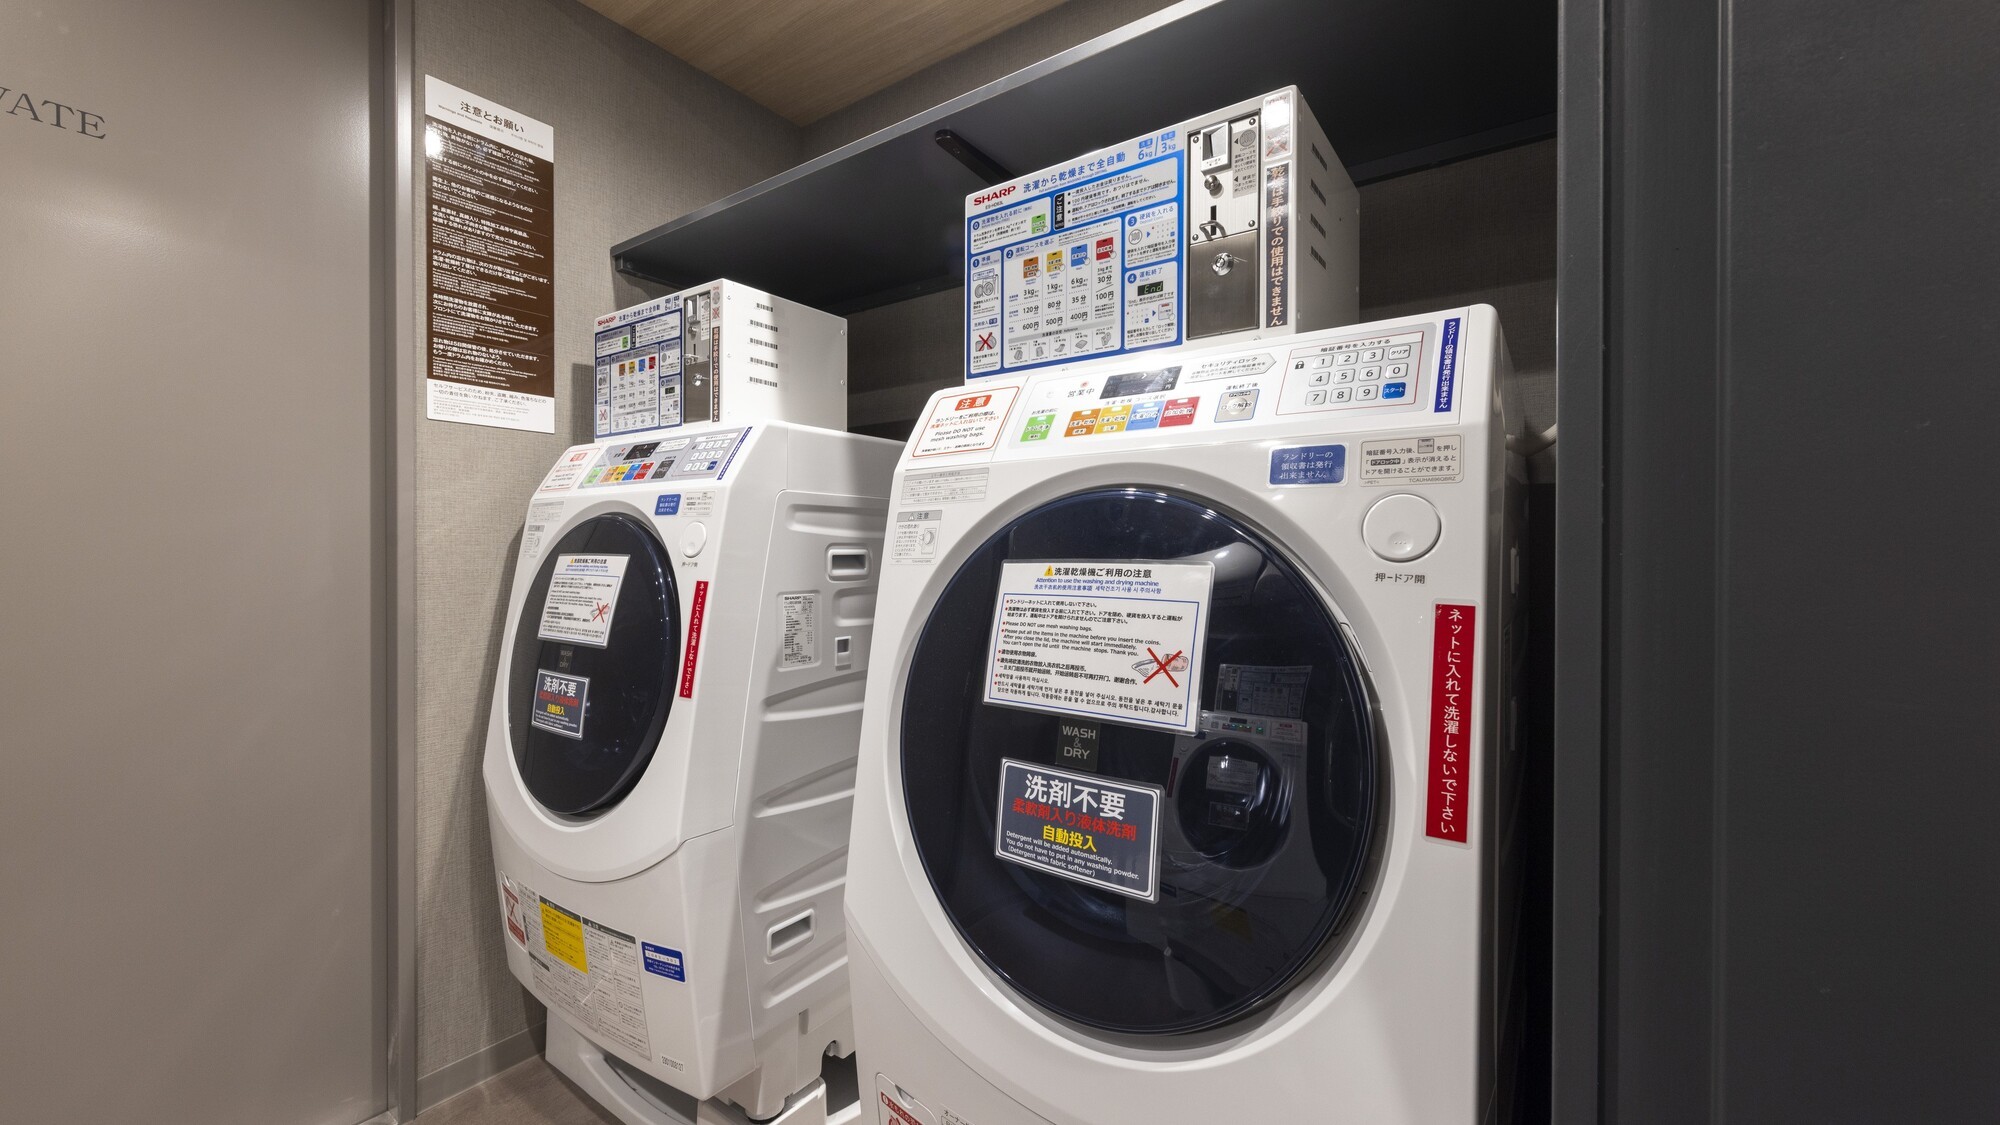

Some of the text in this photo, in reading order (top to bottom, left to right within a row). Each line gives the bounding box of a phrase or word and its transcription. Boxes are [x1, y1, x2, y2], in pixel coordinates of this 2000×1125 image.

[460, 101, 524, 132] 注意とお願い
[1023, 151, 1126, 194] 洗濯から乾燥まで全自動
[974, 186, 1016, 206] SHARP
[1140, 267, 1162, 278] 運転終了
[1096, 291, 1114, 300] 100円
[598, 316, 616, 326] SHARP
[1046, 317, 1063, 326] 500円
[1070, 312, 1088, 320] 400円
[1022, 321, 1039, 330] 600円
[1321, 339, 1390, 352] 暗証番号を入力する
[1202, 356, 1258, 369] セキュリティロック
[1392, 366, 1400, 374] 0
[1313, 394, 1320, 402] 7
[1336, 391, 1344, 399] 8
[1364, 388, 1370, 396] 9
[959, 396, 987, 410] 注意
[1282, 452, 1334, 460] ランドリーの
[1366, 448, 1416, 456] 暗証番号入力後、
[1281, 460, 1332, 470] 領収書は発行
[1365, 465, 1454, 476] ドアを開けることができます。
[1280, 470, 1326, 480] 出来ません。
[1054, 568, 1152, 578] 洗濯乾燥機ご利用の注意
[1104, 642, 1137, 650] immediately.
[544, 676, 577, 697] 洗剤不要
[1440, 608, 1463, 834] ネットに入れて洗濯しないで下さい
[1062, 725, 1096, 740] WASH
[1073, 737, 1082, 748] &
[1064, 746, 1090, 760] DRY
[1024, 773, 1126, 820] 洗剤不要
[1012, 798, 1137, 841] 柔軟剤入り液体洗剤
[1043, 824, 1097, 852] 自動投入
[1006, 830, 1032, 842] Detergent
[1052, 844, 1070, 854] added
[1070, 850, 1112, 866] automatically.
[1008, 845, 1036, 860] (Detergent
[1050, 858, 1066, 868] fabric
[1068, 864, 1096, 877] softener)
[1034, 846, 1048, 855] have
[1074, 858, 1086, 866] any
[1086, 862, 1112, 874] washing
[1114, 868, 1140, 880] powder.
